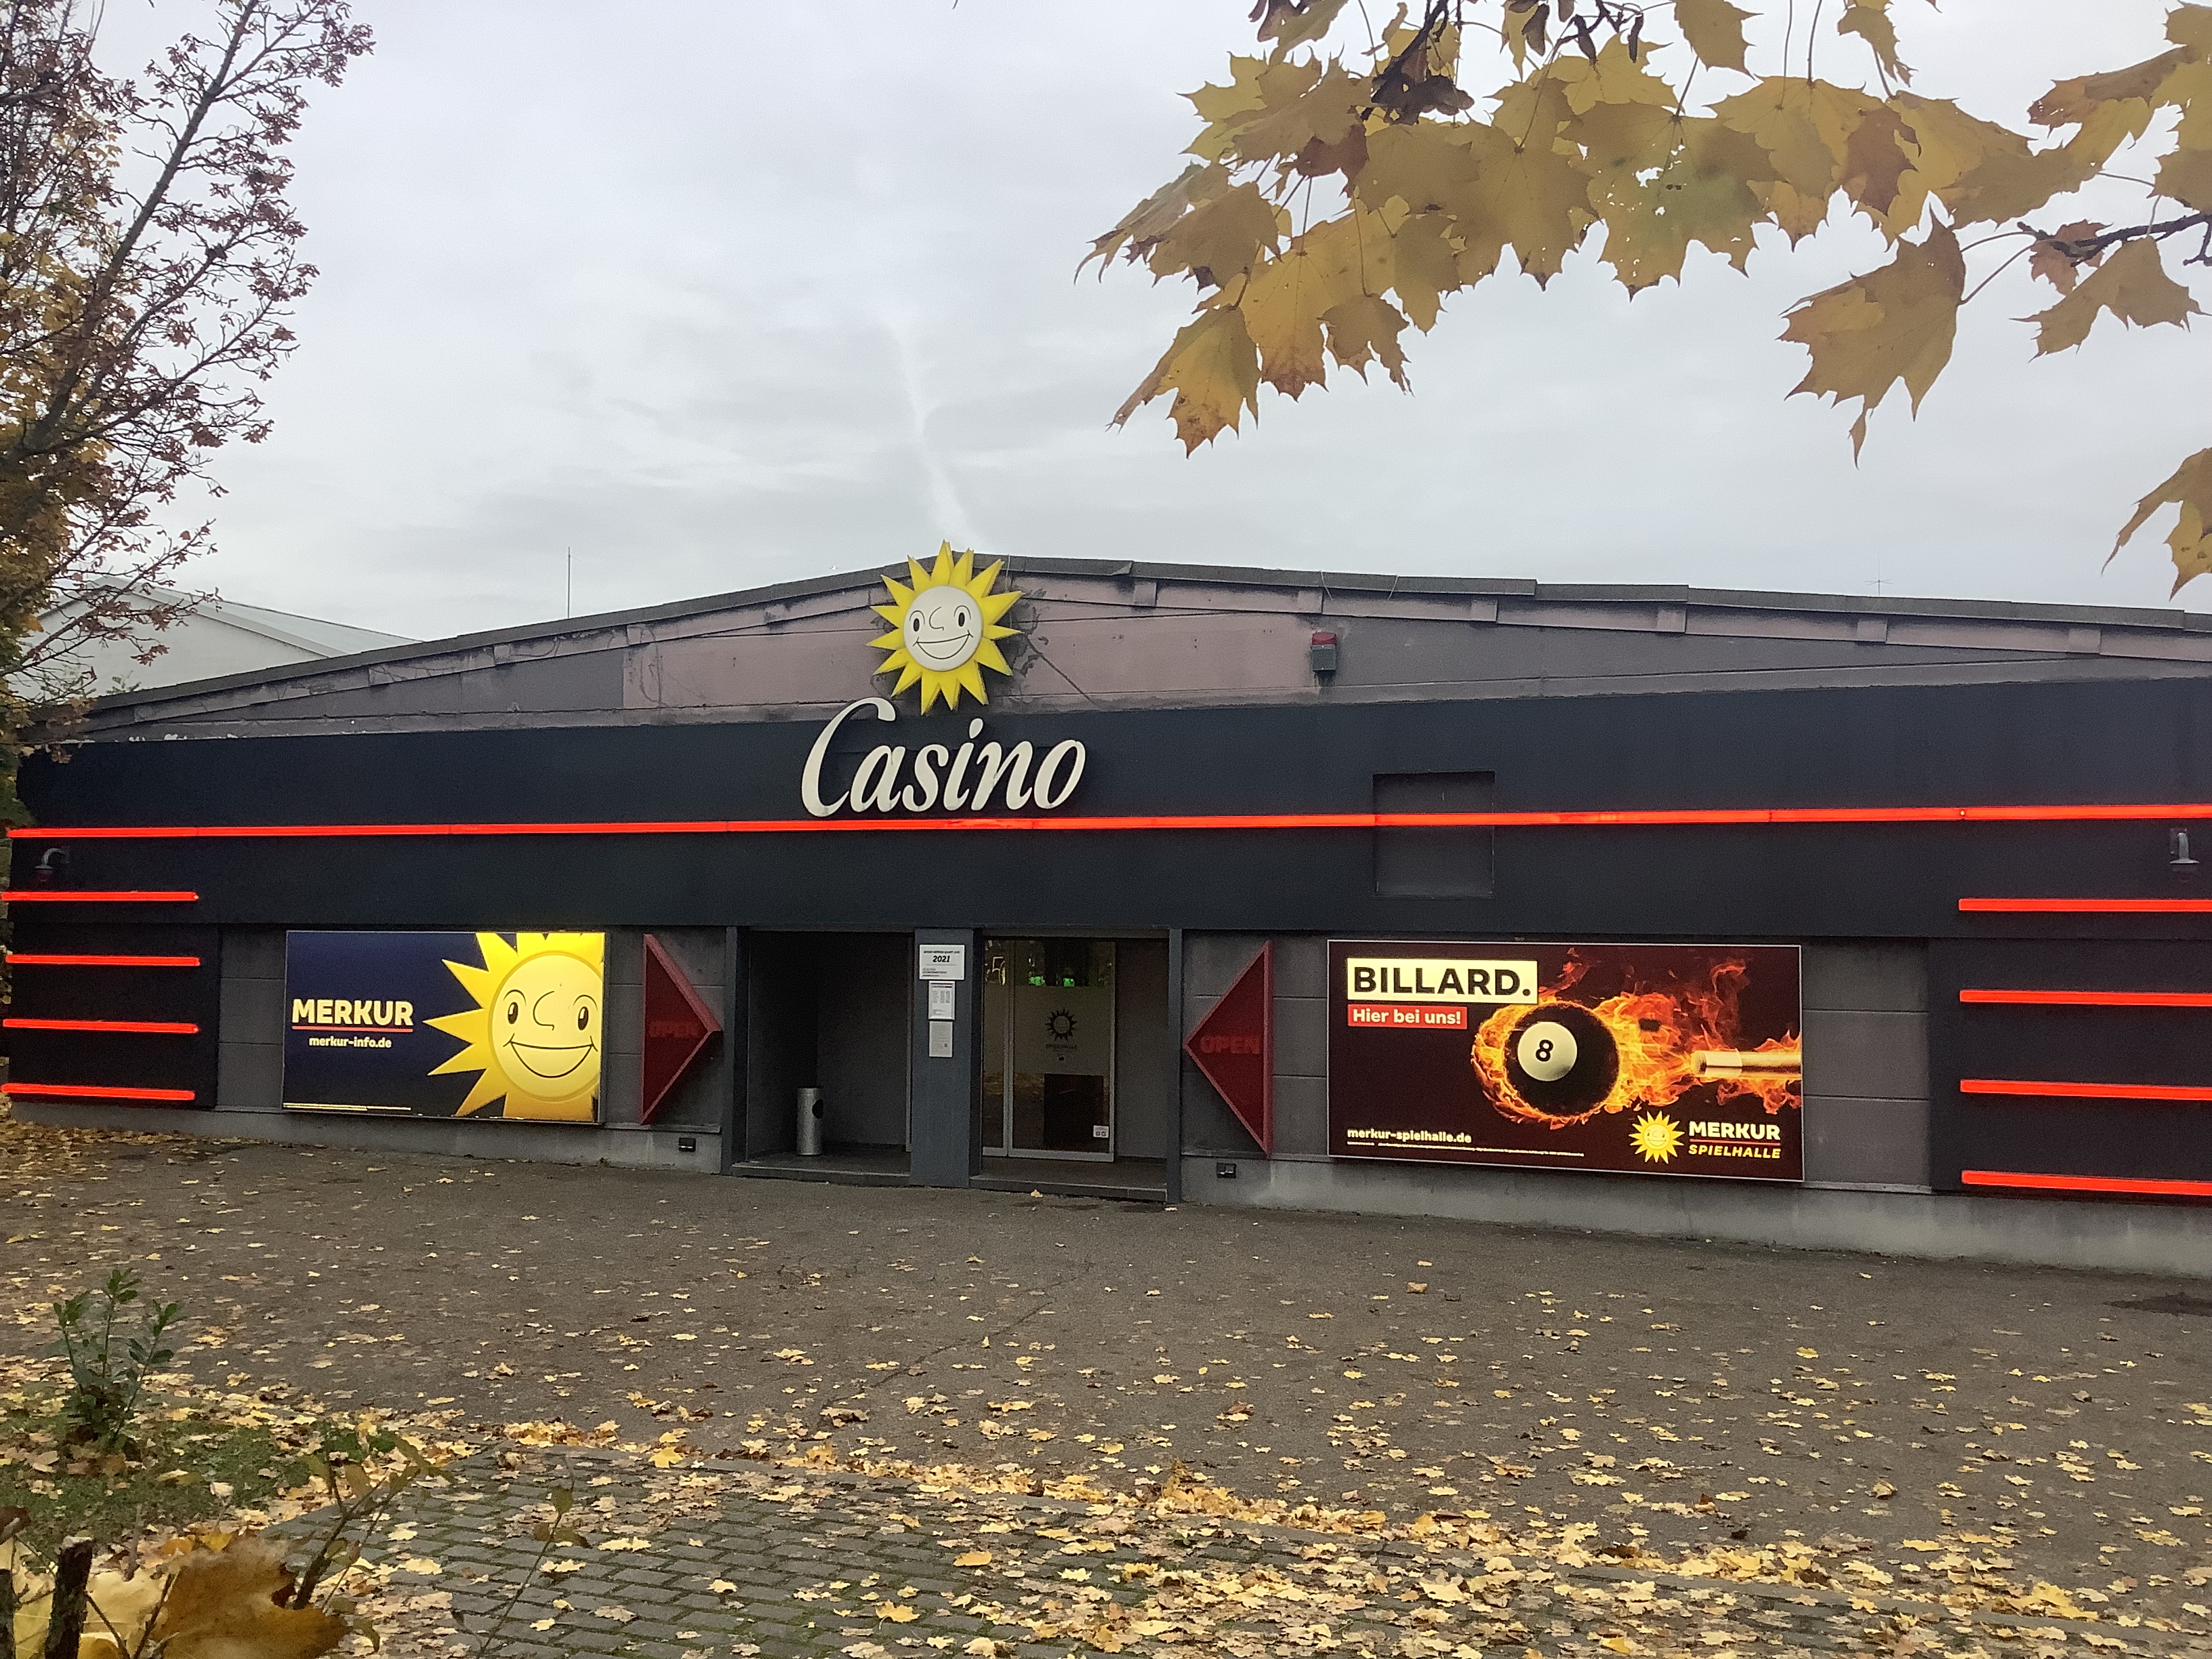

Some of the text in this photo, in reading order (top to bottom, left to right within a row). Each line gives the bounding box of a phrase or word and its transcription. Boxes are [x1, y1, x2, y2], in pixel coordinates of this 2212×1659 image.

[801, 697, 1086, 818] Casino
[1353, 966, 1532, 997] BILLARD.
[291, 998, 414, 1026] MERKUR
[1353, 1008, 1462, 1025] Hier bei uns!
[308, 1036, 392, 1048] merkur-info.de
[1200, 1036, 1260, 1054] OPEN
[1535, 1039, 1554, 1062] 8
[1347, 1128, 1472, 1143] merkur-spielhalle.de
[1688, 1121, 1780, 1140] MERKUR
[1688, 1145, 1781, 1159] SPIELHALLE
